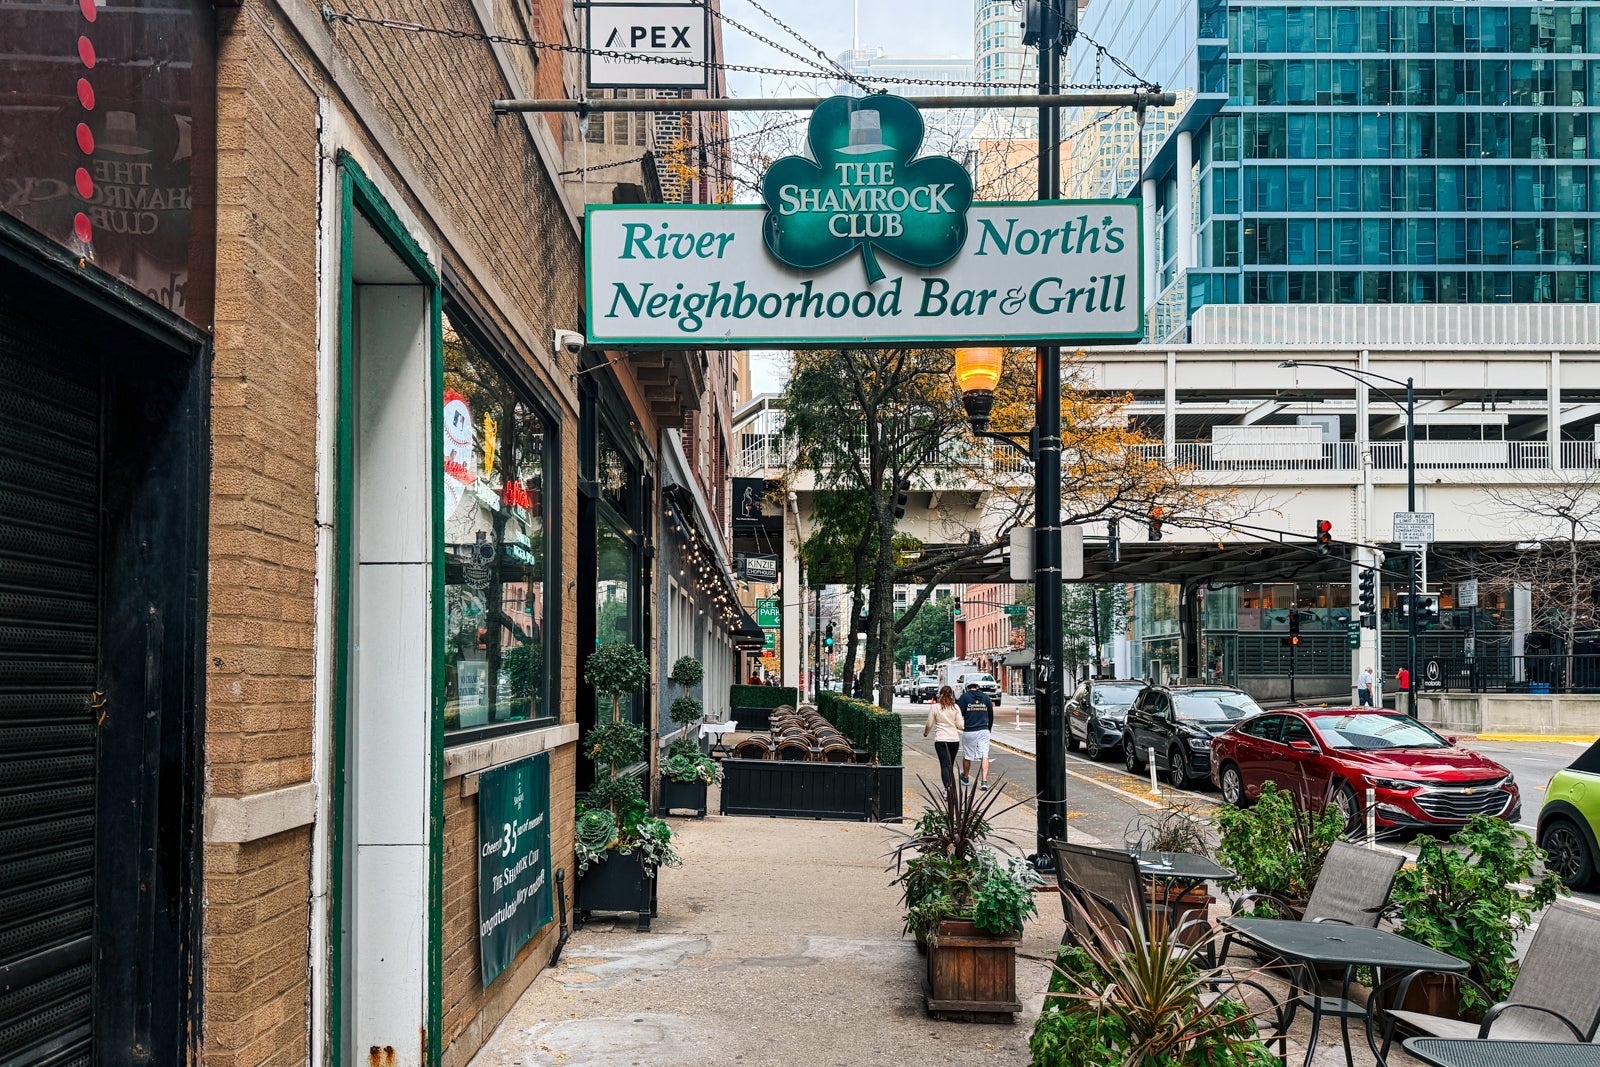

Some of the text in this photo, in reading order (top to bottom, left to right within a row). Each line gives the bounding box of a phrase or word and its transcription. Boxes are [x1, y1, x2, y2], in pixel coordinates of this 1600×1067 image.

[605, 26, 691, 48] APEX
[835, 162, 894, 186] THE
[779, 183, 955, 215] SHAMROCK
[618, 222, 735, 259] River
[829, 214, 903, 237] CLUB
[604, 274, 1126, 333] Neighborhood Bar & Grill
[747, 560, 775, 569] KINZIE
[502, 820, 517, 858] 35
[504, 855, 528, 886] SHAOK
